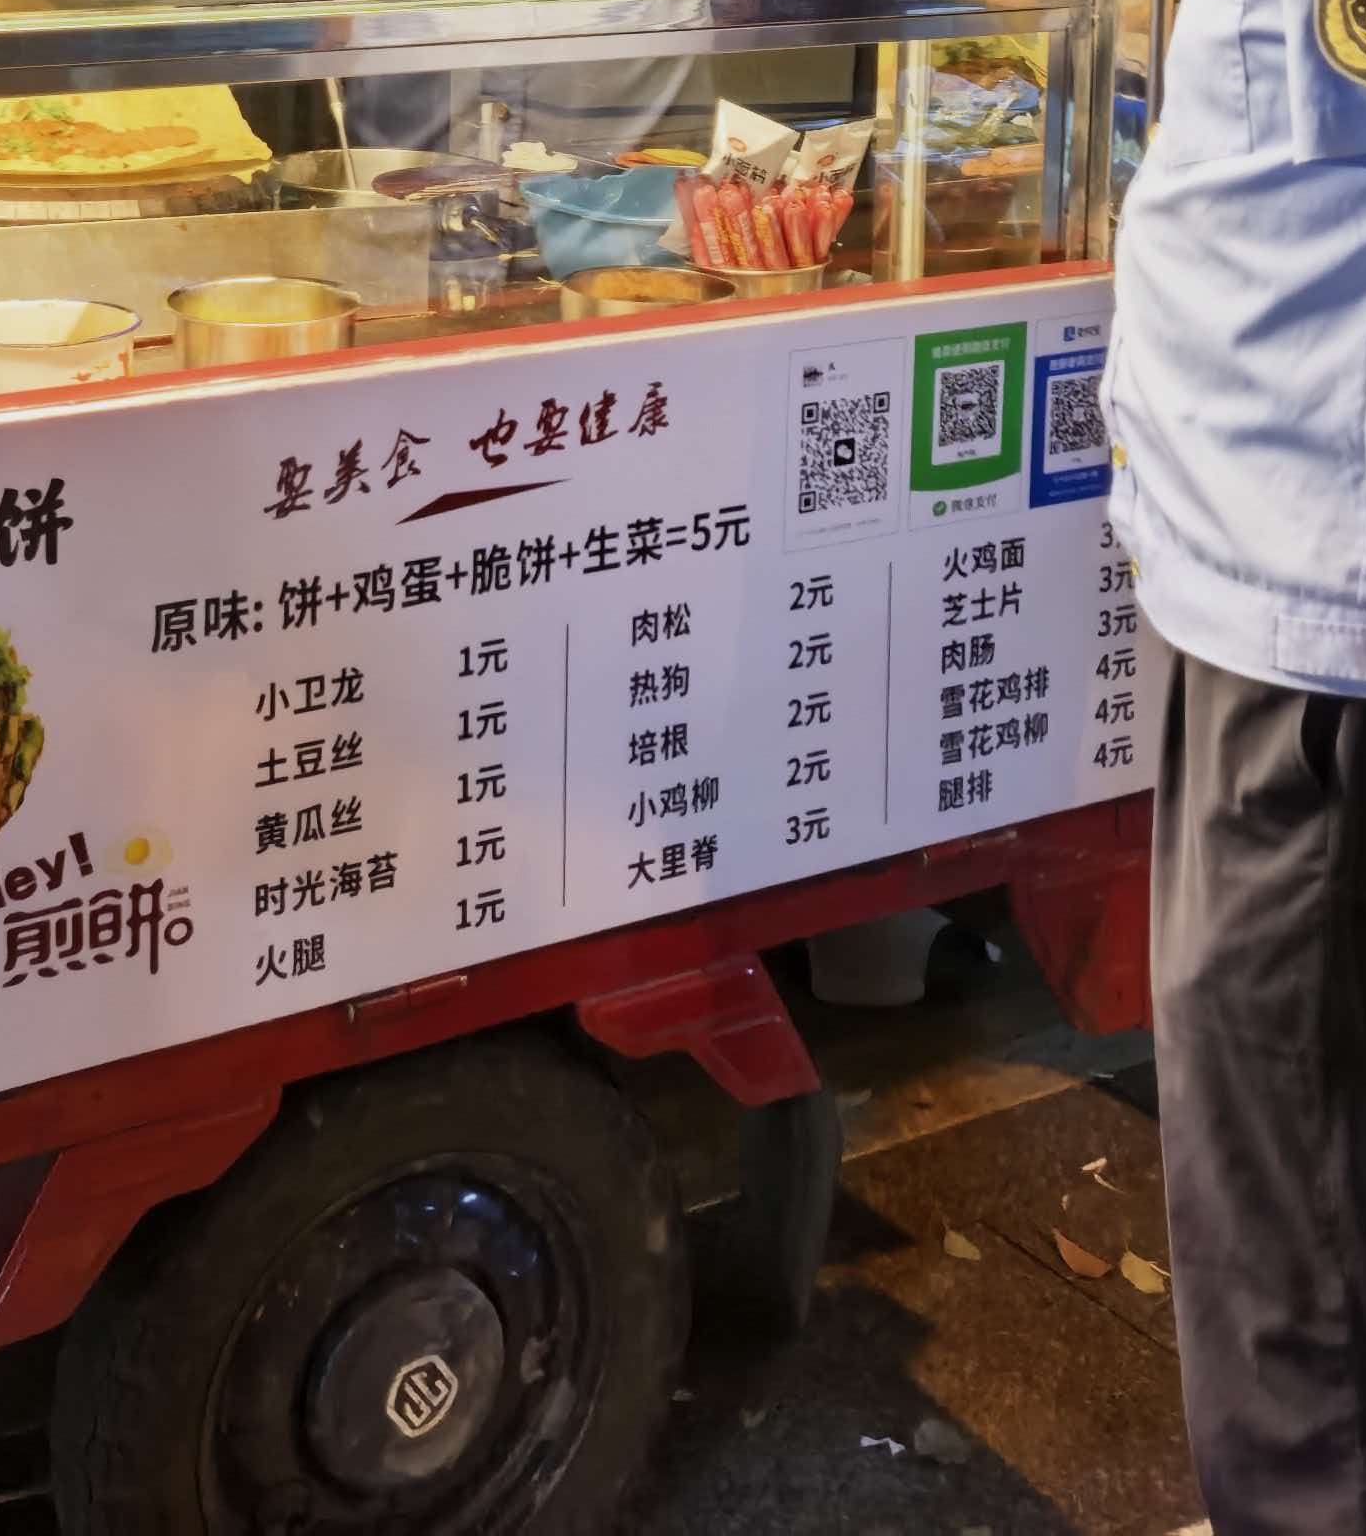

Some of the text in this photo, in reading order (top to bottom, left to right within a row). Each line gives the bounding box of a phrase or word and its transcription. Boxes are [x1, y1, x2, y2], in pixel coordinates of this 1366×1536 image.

[469, 381, 670, 468] 也要健康
[943, 522, 1122, 582] 火鸡面 3
[632, 574, 834, 647] 肉松 2元
[942, 560, 1136, 627] 芝士片 3元
[630, 632, 832, 708] 热狗 2元
[941, 604, 1137, 674] 肉肠 3元
[256, 637, 508, 721] 小卫龙 1元
[940, 647, 1136, 720] 雪花鸡排 4元
[255, 701, 507, 787] 土豆丝 1元
[628, 691, 831, 766] 培根 2元
[939, 692, 1134, 766] 雪花鸡柳 4元
[255, 764, 506, 854] 黄瓜丝 1元
[628, 749, 831, 828] 小鸡柳 2元
[938, 736, 1133, 812] 腿排 4元
[255, 826, 505, 916] 时光海苔 1元
[628, 807, 830, 889] 大里脊 3元
[255, 888, 505, 986] 火腿 1元
